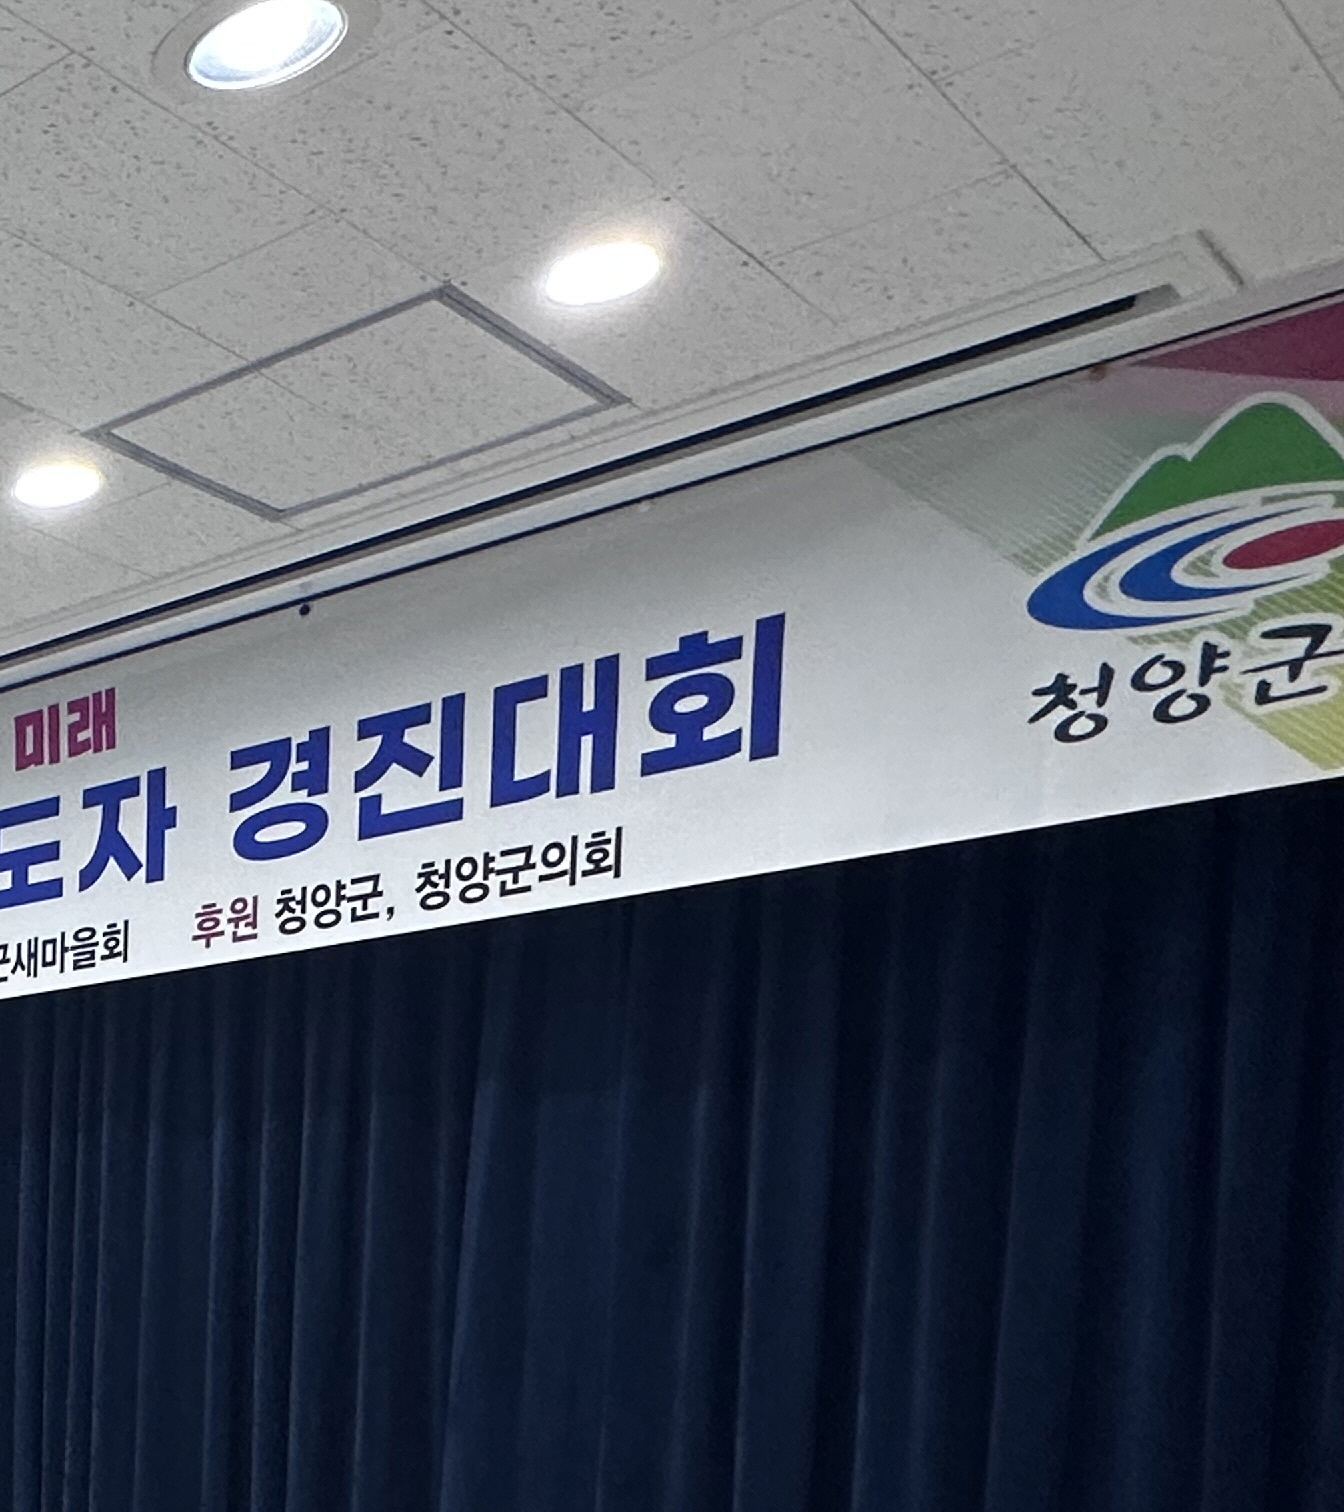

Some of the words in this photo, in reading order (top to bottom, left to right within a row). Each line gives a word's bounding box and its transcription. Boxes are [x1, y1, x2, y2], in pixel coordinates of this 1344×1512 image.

[14, 687, 118, 772] 미래
[228, 611, 787, 862] 경진대회
[1027, 623, 1344, 744] 청양군
[192, 895, 259, 949] 후원
[273, 873, 396, 937] 청양군,
[415, 827, 625, 911] 청양군의회
